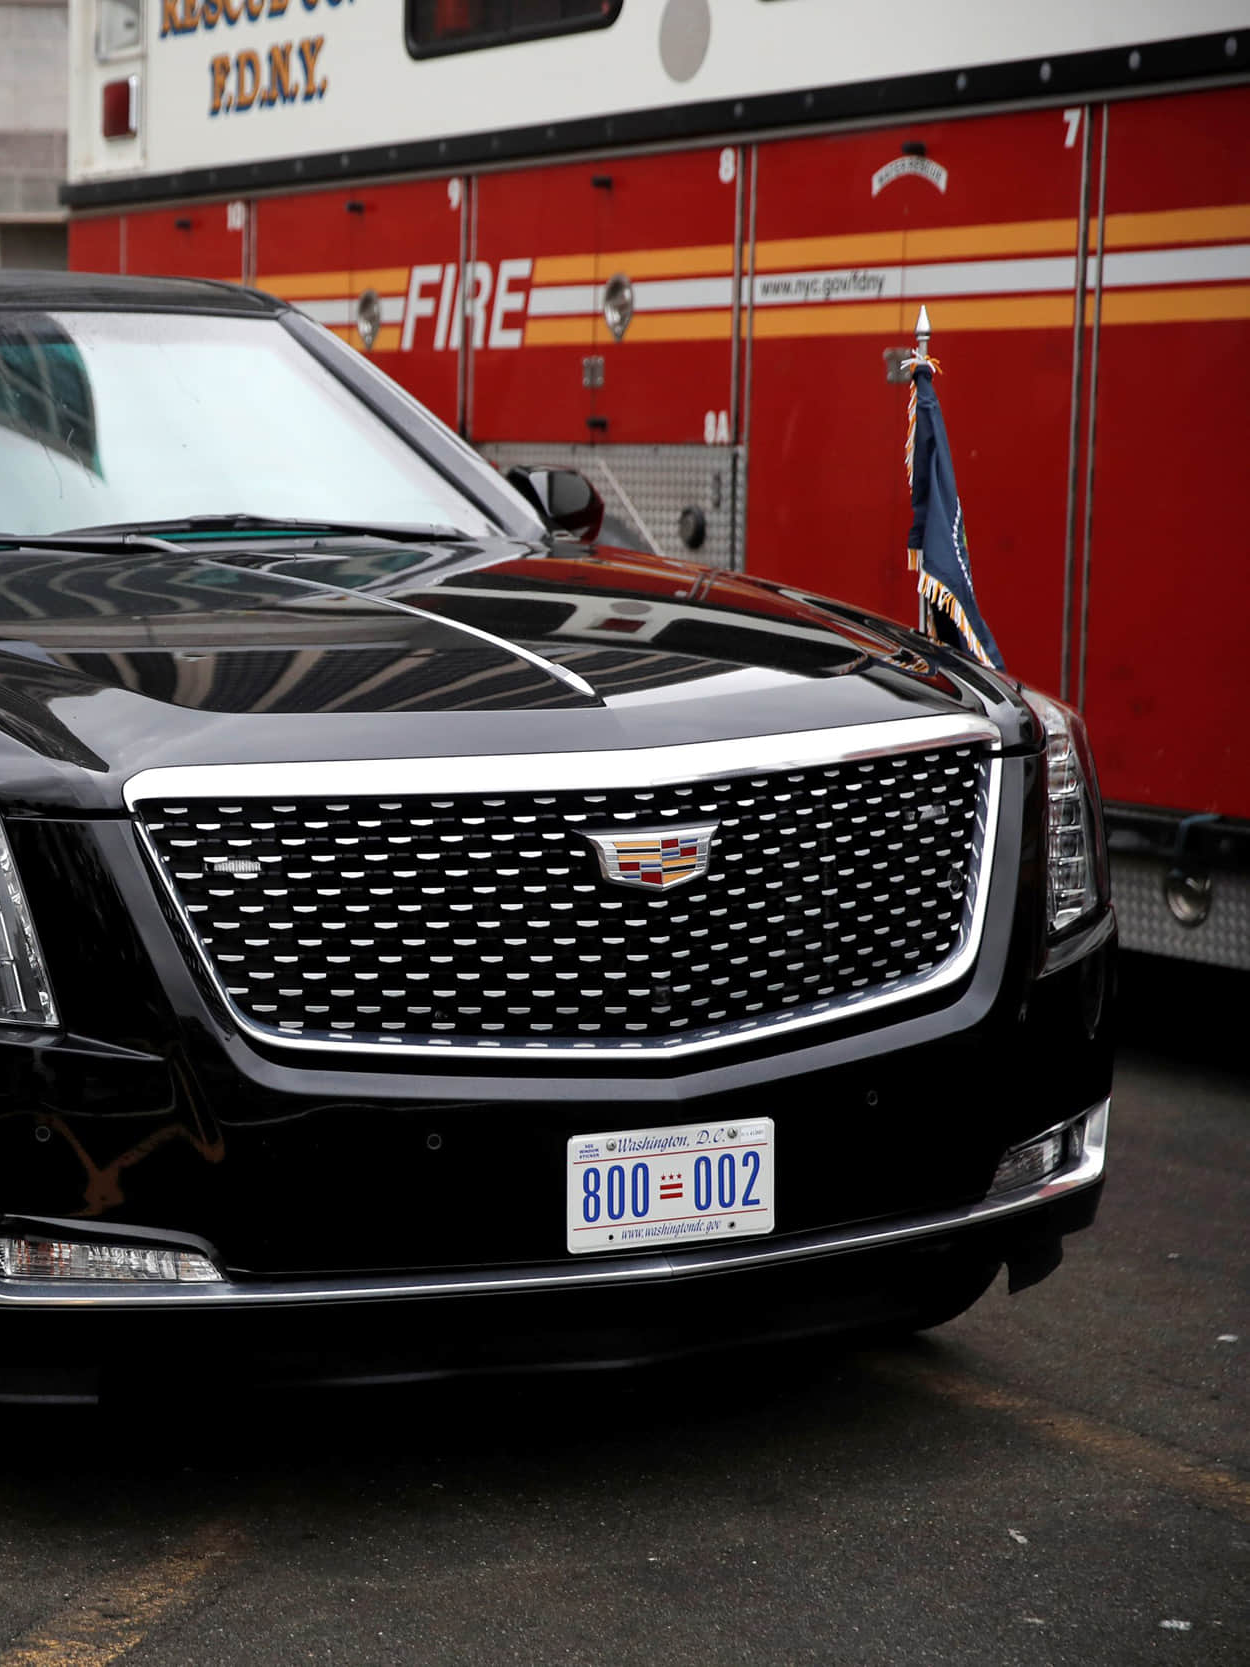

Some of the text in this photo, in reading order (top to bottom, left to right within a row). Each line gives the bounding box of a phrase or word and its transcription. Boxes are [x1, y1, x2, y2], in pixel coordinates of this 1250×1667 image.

[209, 35, 328, 116] F.D.N.Y.
[1063, 109, 1081, 148] 7
[718, 147, 735, 183] 8
[448, 177, 461, 211] 9
[227, 201, 245, 230] 10
[760, 271, 885, 301] www.nyc.gov/fdny
[401, 258, 533, 351] FIRE
[704, 410, 729, 444] 8A
[696, 1127, 726, 1145] D.C.
[583, 1150, 761, 1223] 800 002
[621, 1219, 722, 1241] www.washingtondc.gov
